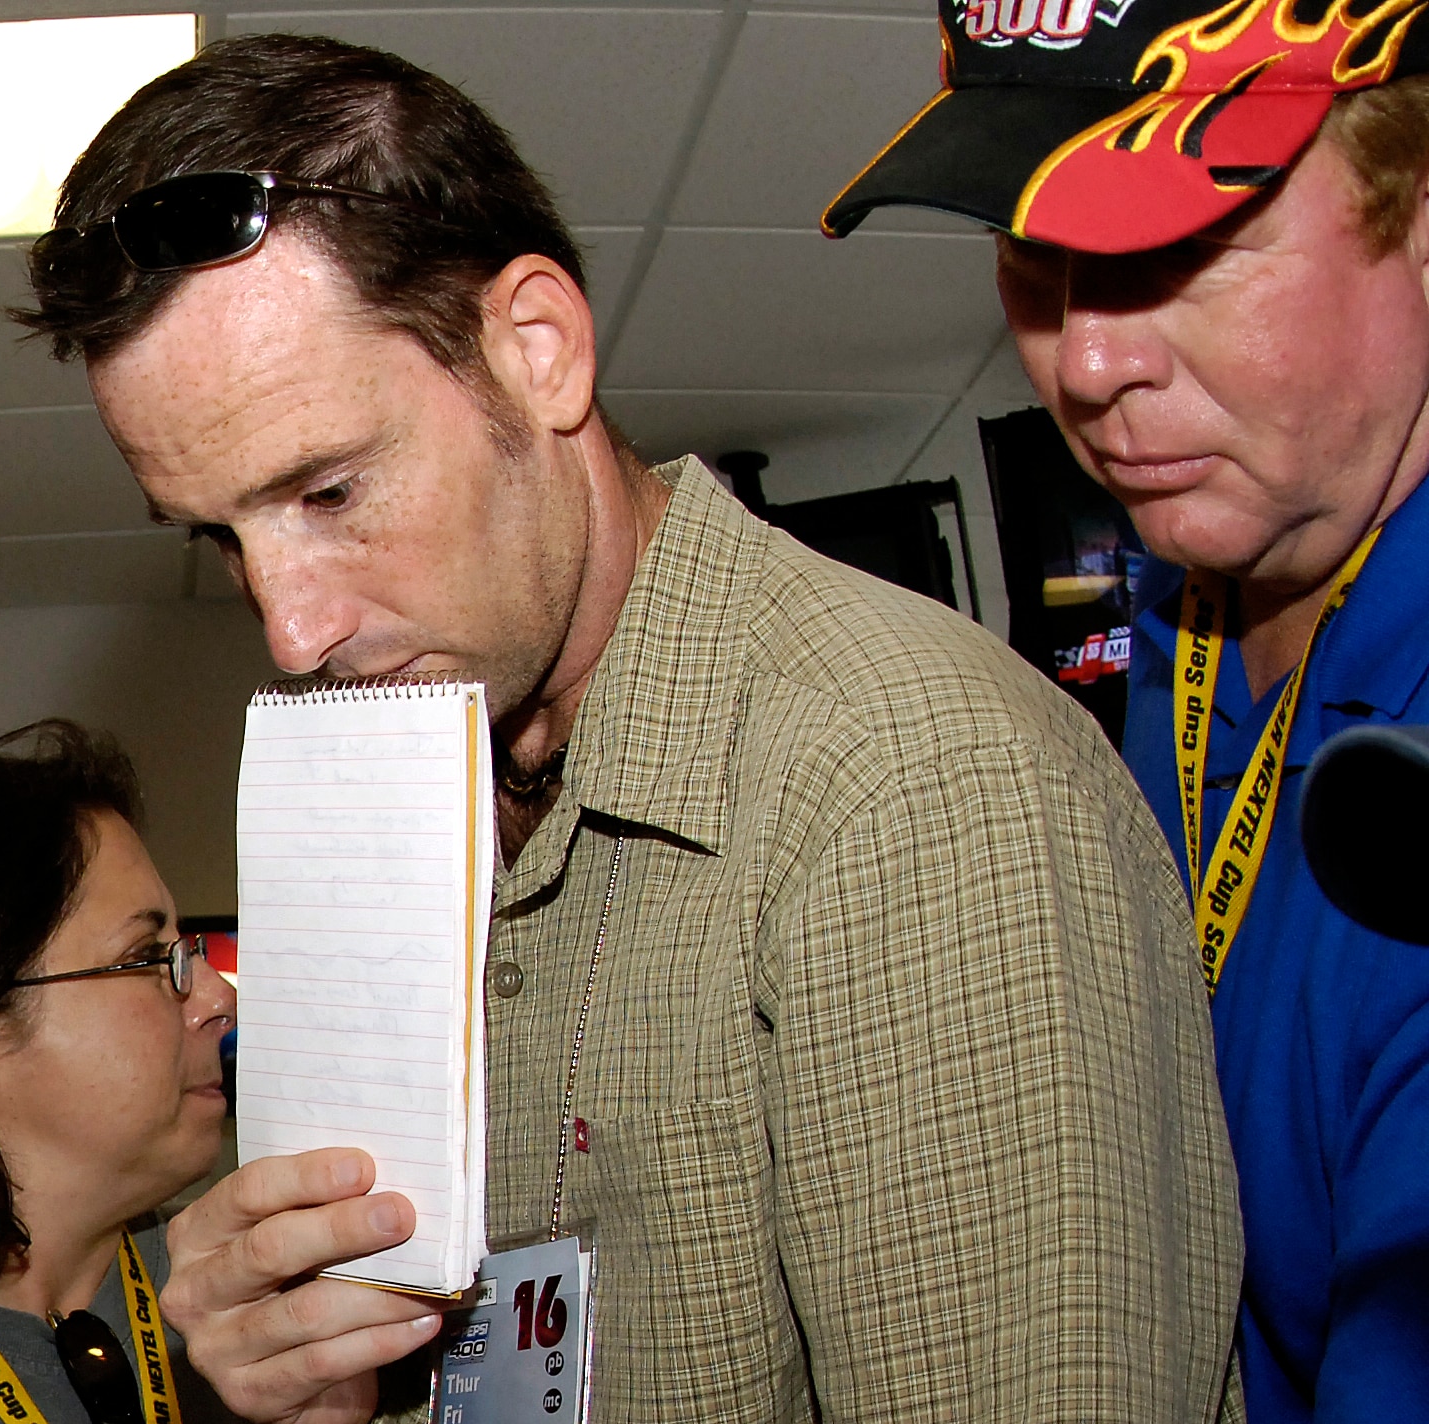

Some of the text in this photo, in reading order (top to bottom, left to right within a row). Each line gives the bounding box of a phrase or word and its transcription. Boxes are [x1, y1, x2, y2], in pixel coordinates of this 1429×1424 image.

[1181, 696, 1205, 751] Cup
[1229, 747, 1277, 859] NEXTEL
[1206, 858, 1244, 918] Cup
[136, 1293, 151, 1324] Cup
[512, 1273, 568, 1352] 16
[141, 1330, 168, 1397] NEXTEL
[449, 1339, 487, 1361] 400
[547, 1353, 563, 1373] pb
[445, 1373, 481, 1395] Thur
[543, 1396, 561, 1408] mc
